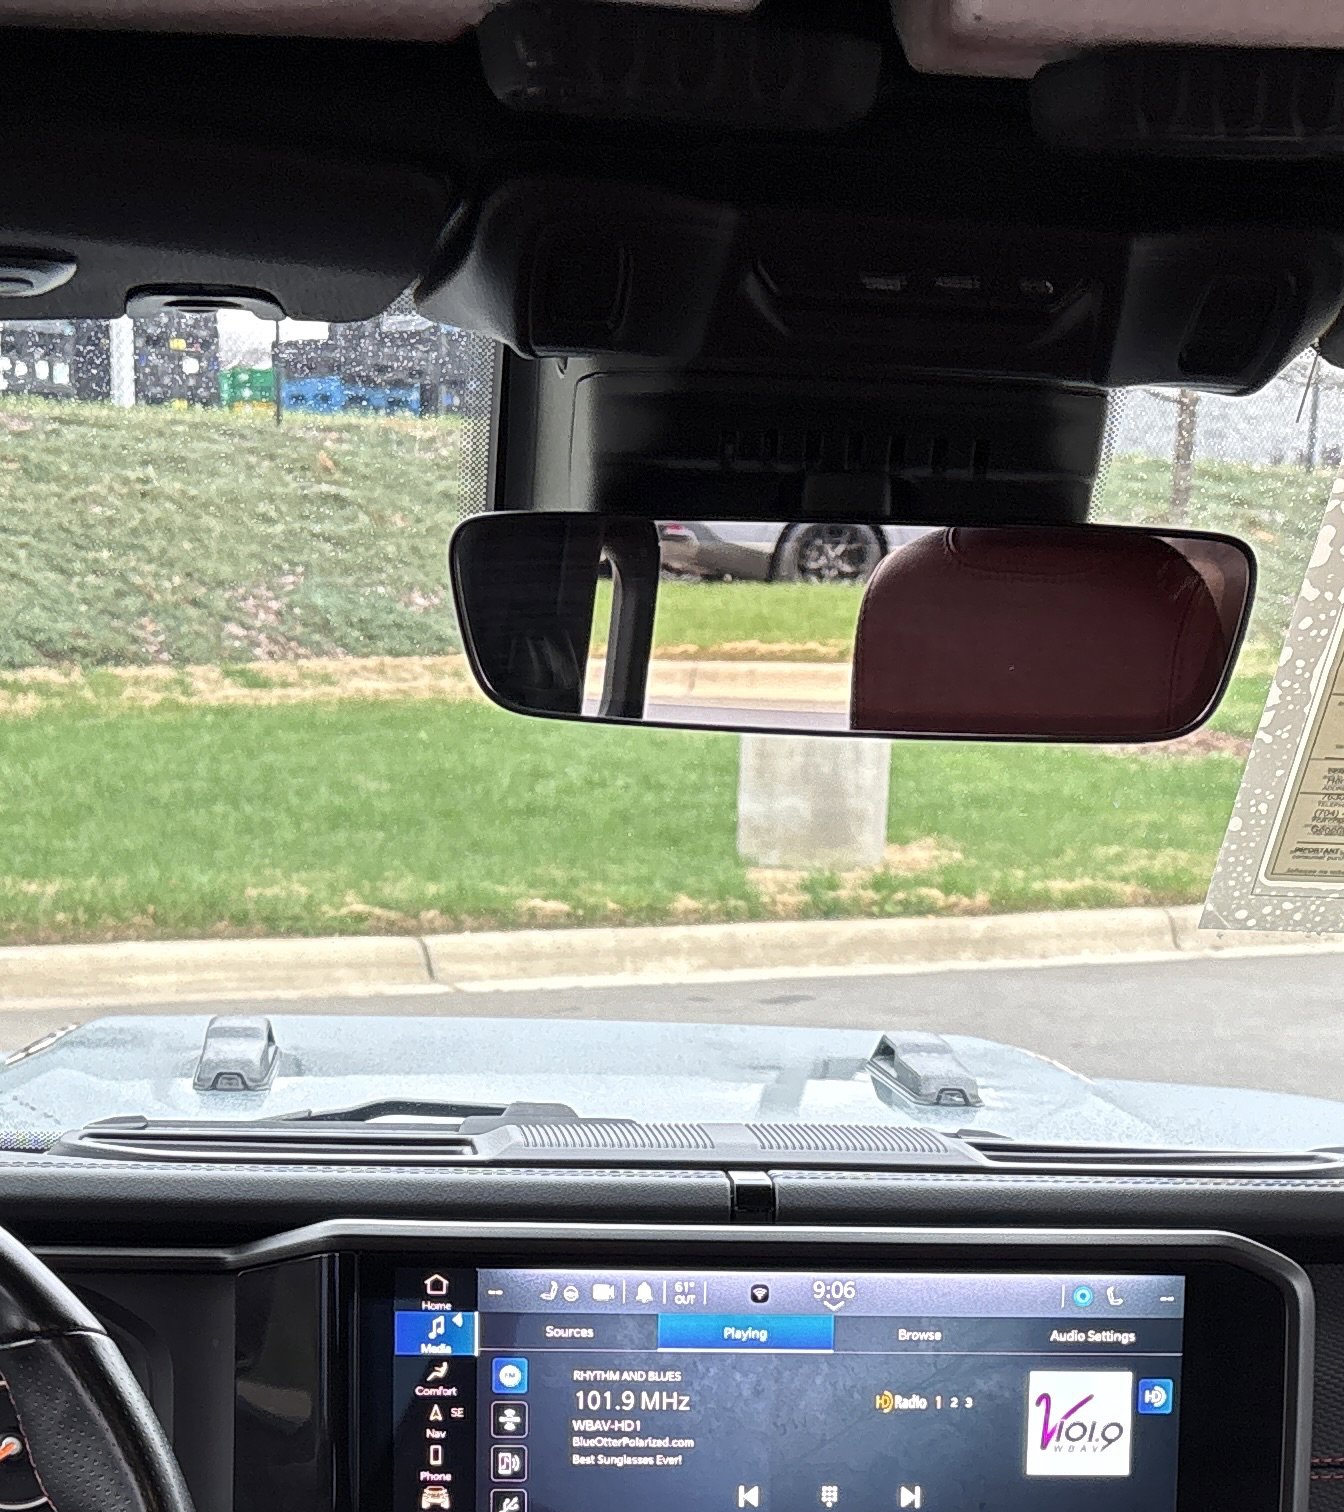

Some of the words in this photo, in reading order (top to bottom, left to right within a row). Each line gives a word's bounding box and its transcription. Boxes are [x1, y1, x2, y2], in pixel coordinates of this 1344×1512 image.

[673, 1281, 696, 1294] 61°
[812, 1279, 857, 1300] 9:06
[421, 1299, 453, 1312] Home
[673, 1294, 696, 1306] OUT
[544, 1324, 595, 1339] Sources
[723, 1325, 769, 1343] Playing
[897, 1328, 943, 1342] Browse
[1049, 1329, 1086, 1344] Audio
[1087, 1330, 1137, 1345] Settings
[420, 1342, 453, 1355] Media
[572, 1370, 621, 1383] RHYTHM
[622, 1370, 647, 1383] AND
[647, 1370, 683, 1383] BLUES
[414, 1385, 458, 1398] Comfort
[574, 1389, 636, 1412] 101.9
[639, 1389, 692, 1412] MHz
[894, 1394, 928, 1411] Radio
[450, 1407, 465, 1419] SE
[571, 1419, 642, 1433] WBAV-HD1
[425, 1427, 447, 1440] Nav
[571, 1436, 695, 1450] BlueOtterPolarized.com
[571, 1453, 596, 1466] Best
[597, 1453, 655, 1468] Sunglasses
[656, 1453, 683, 1466] Ever!
[419, 1471, 453, 1482] Phone
